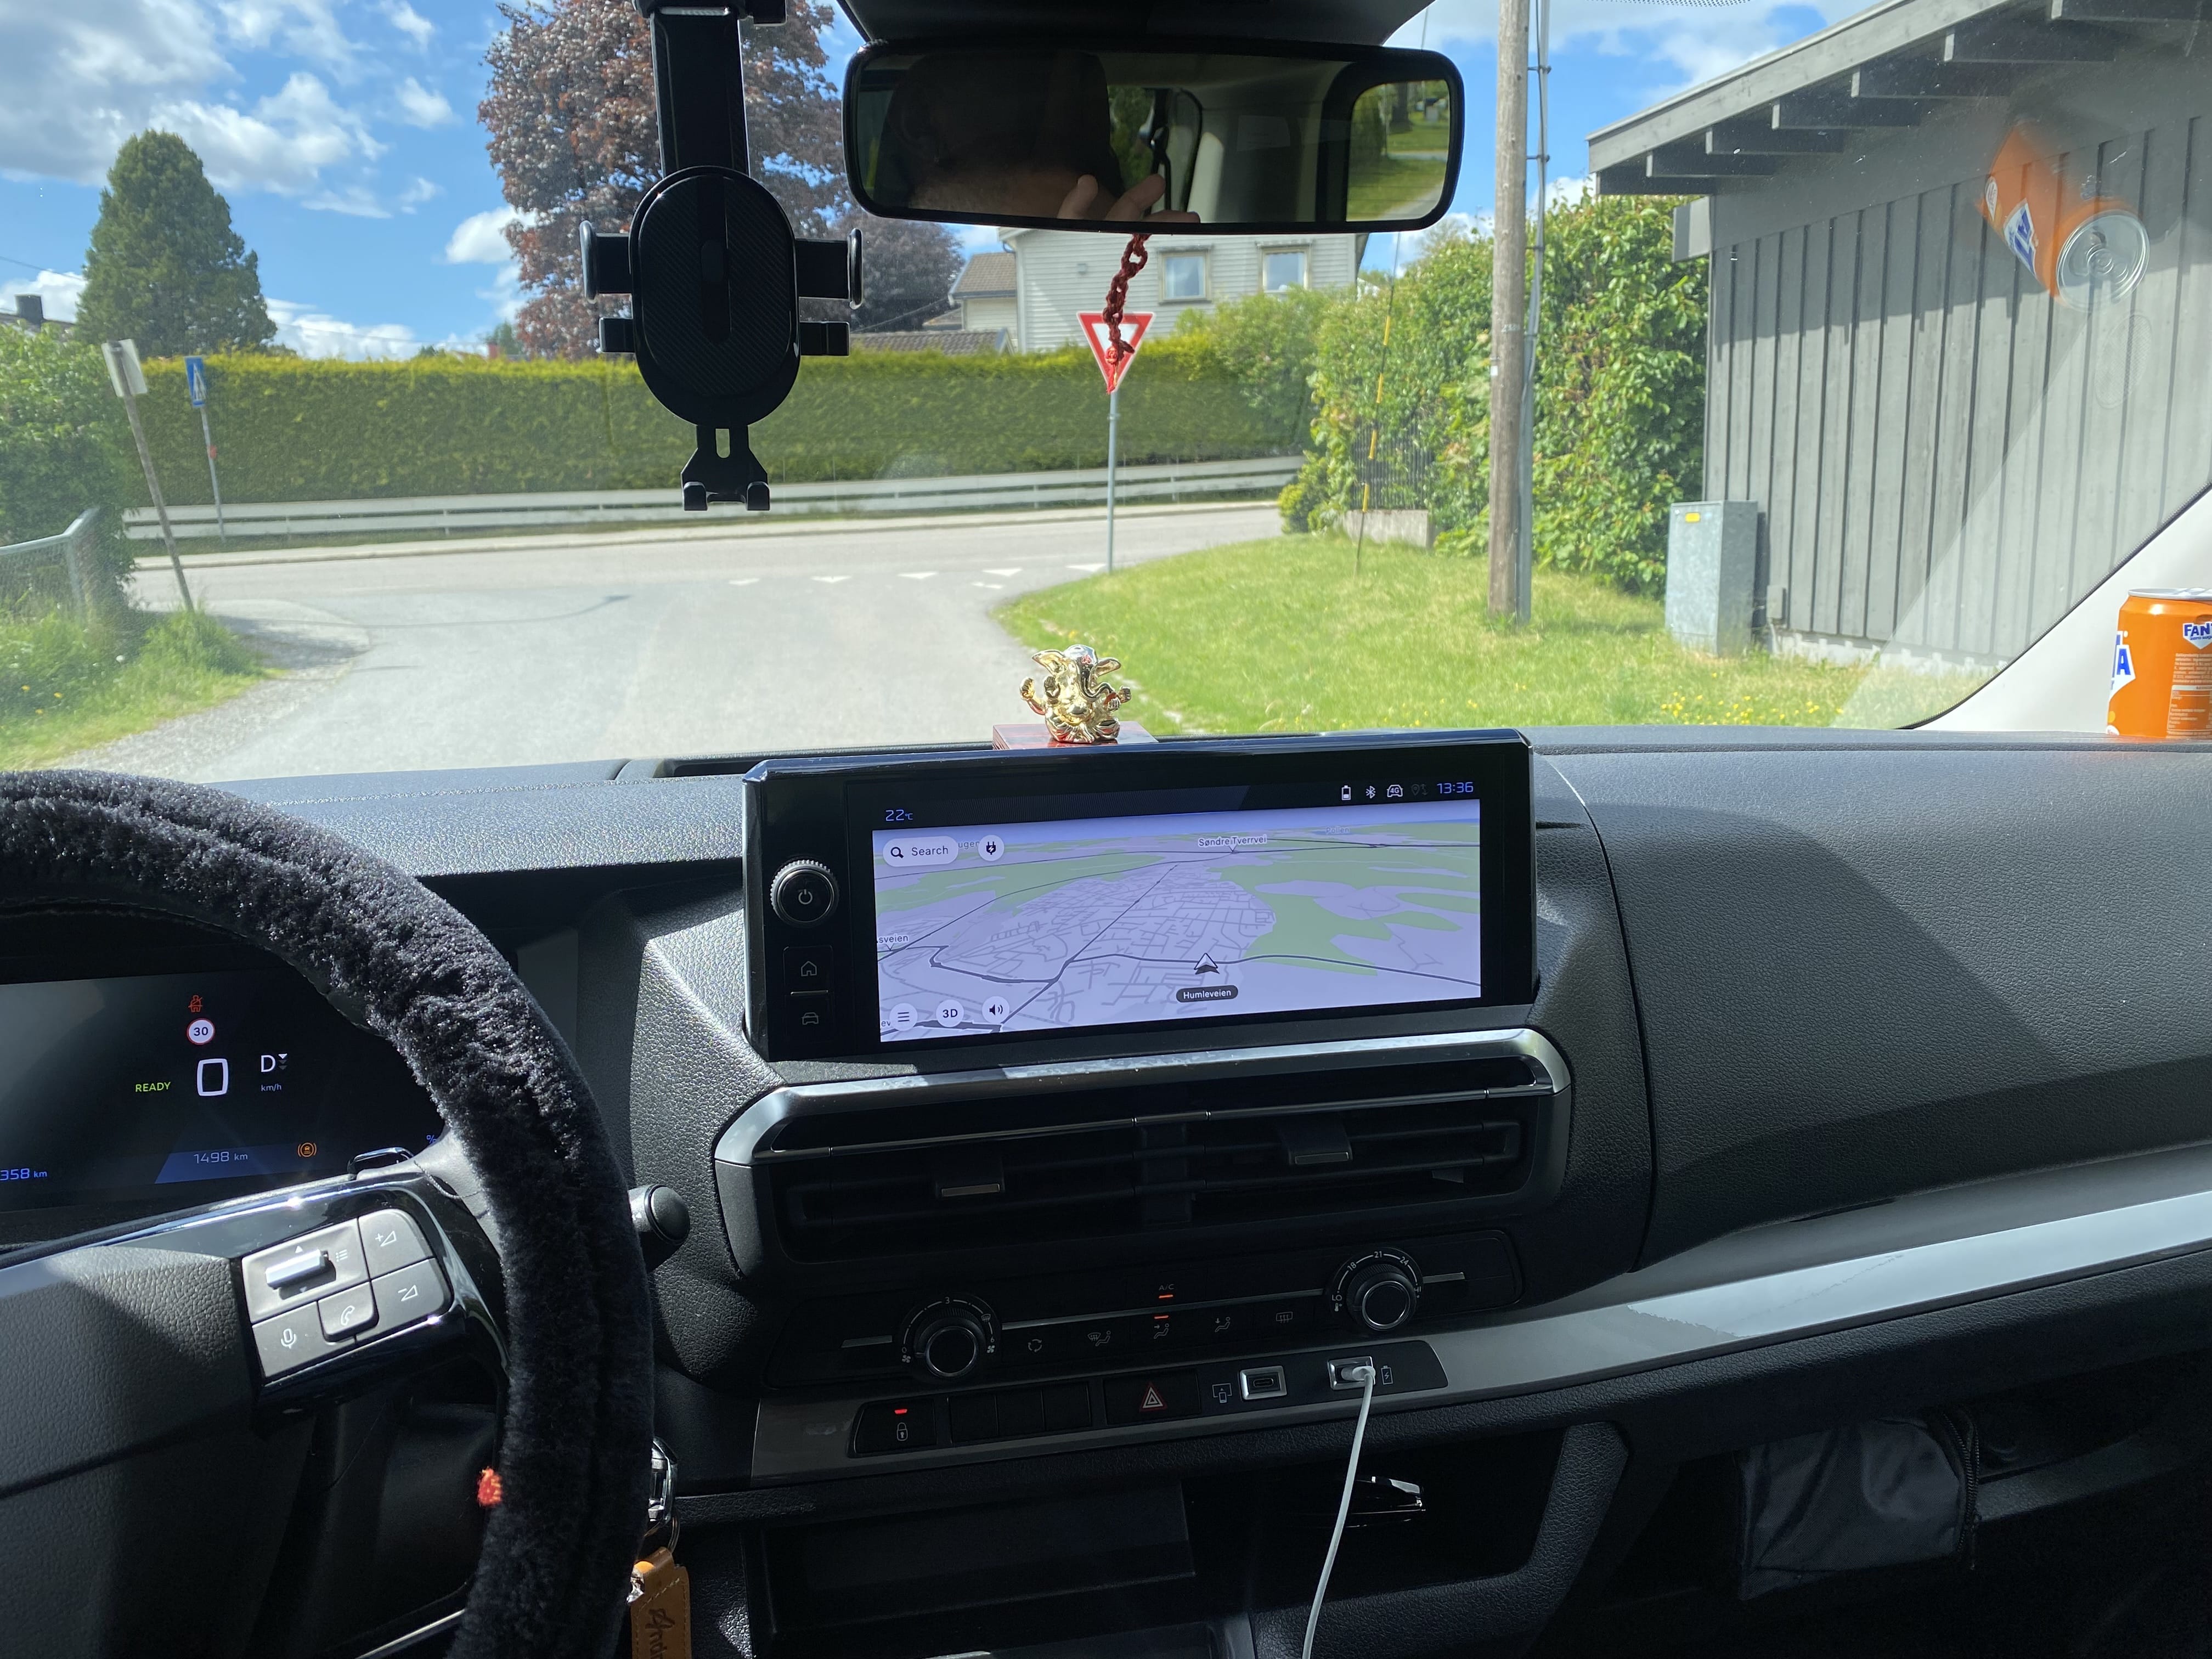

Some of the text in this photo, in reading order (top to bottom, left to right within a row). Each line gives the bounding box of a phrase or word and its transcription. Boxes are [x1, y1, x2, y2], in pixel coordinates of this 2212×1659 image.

[2184, 623, 2212, 636] FAN
[1436, 782, 1474, 794] 13:36
[1199, 835, 1267, 847] Søndre Tverrvei
[911, 845, 949, 856] Search
[878, 934, 909, 943] sveien
[1183, 989, 1232, 1000] Humleveien
[943, 1008, 958, 1018] 3D
[193, 1026, 208, 1036] 30
[260, 1054, 276, 1073] D
[196, 1058, 229, 1097] 0
[135, 1081, 171, 1093] READY
[261, 1084, 282, 1092] km/h
[193, 1151, 248, 1164] 1498 km
[33, 1170, 47, 1178] km
[1374, 1250, 1383, 1259] 21
[1347, 1262, 1357, 1271] 18
[1400, 1256, 1409, 1266] 24
